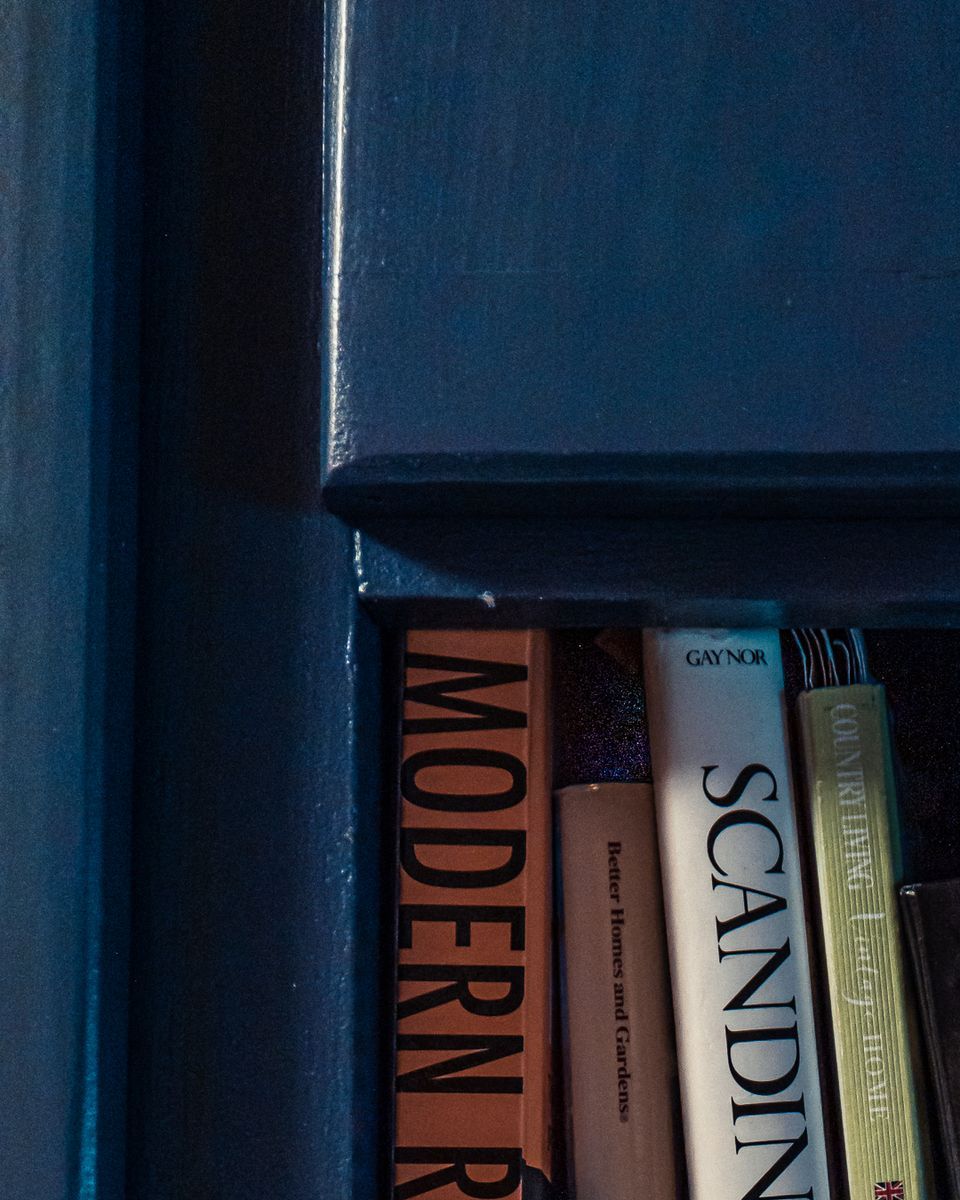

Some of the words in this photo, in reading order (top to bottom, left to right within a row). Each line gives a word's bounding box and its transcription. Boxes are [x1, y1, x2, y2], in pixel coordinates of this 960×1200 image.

[686, 648, 768, 667] GAYNOR
[831, 703, 867, 806] COUNTRY
[396, 652, 528, 1095] MODERN
[607, 841, 622, 902] Better
[842, 815, 875, 891] LIVING
[610, 908, 625, 978] Homes
[613, 983, 629, 1021] and
[863, 1033, 890, 1121] HOME
